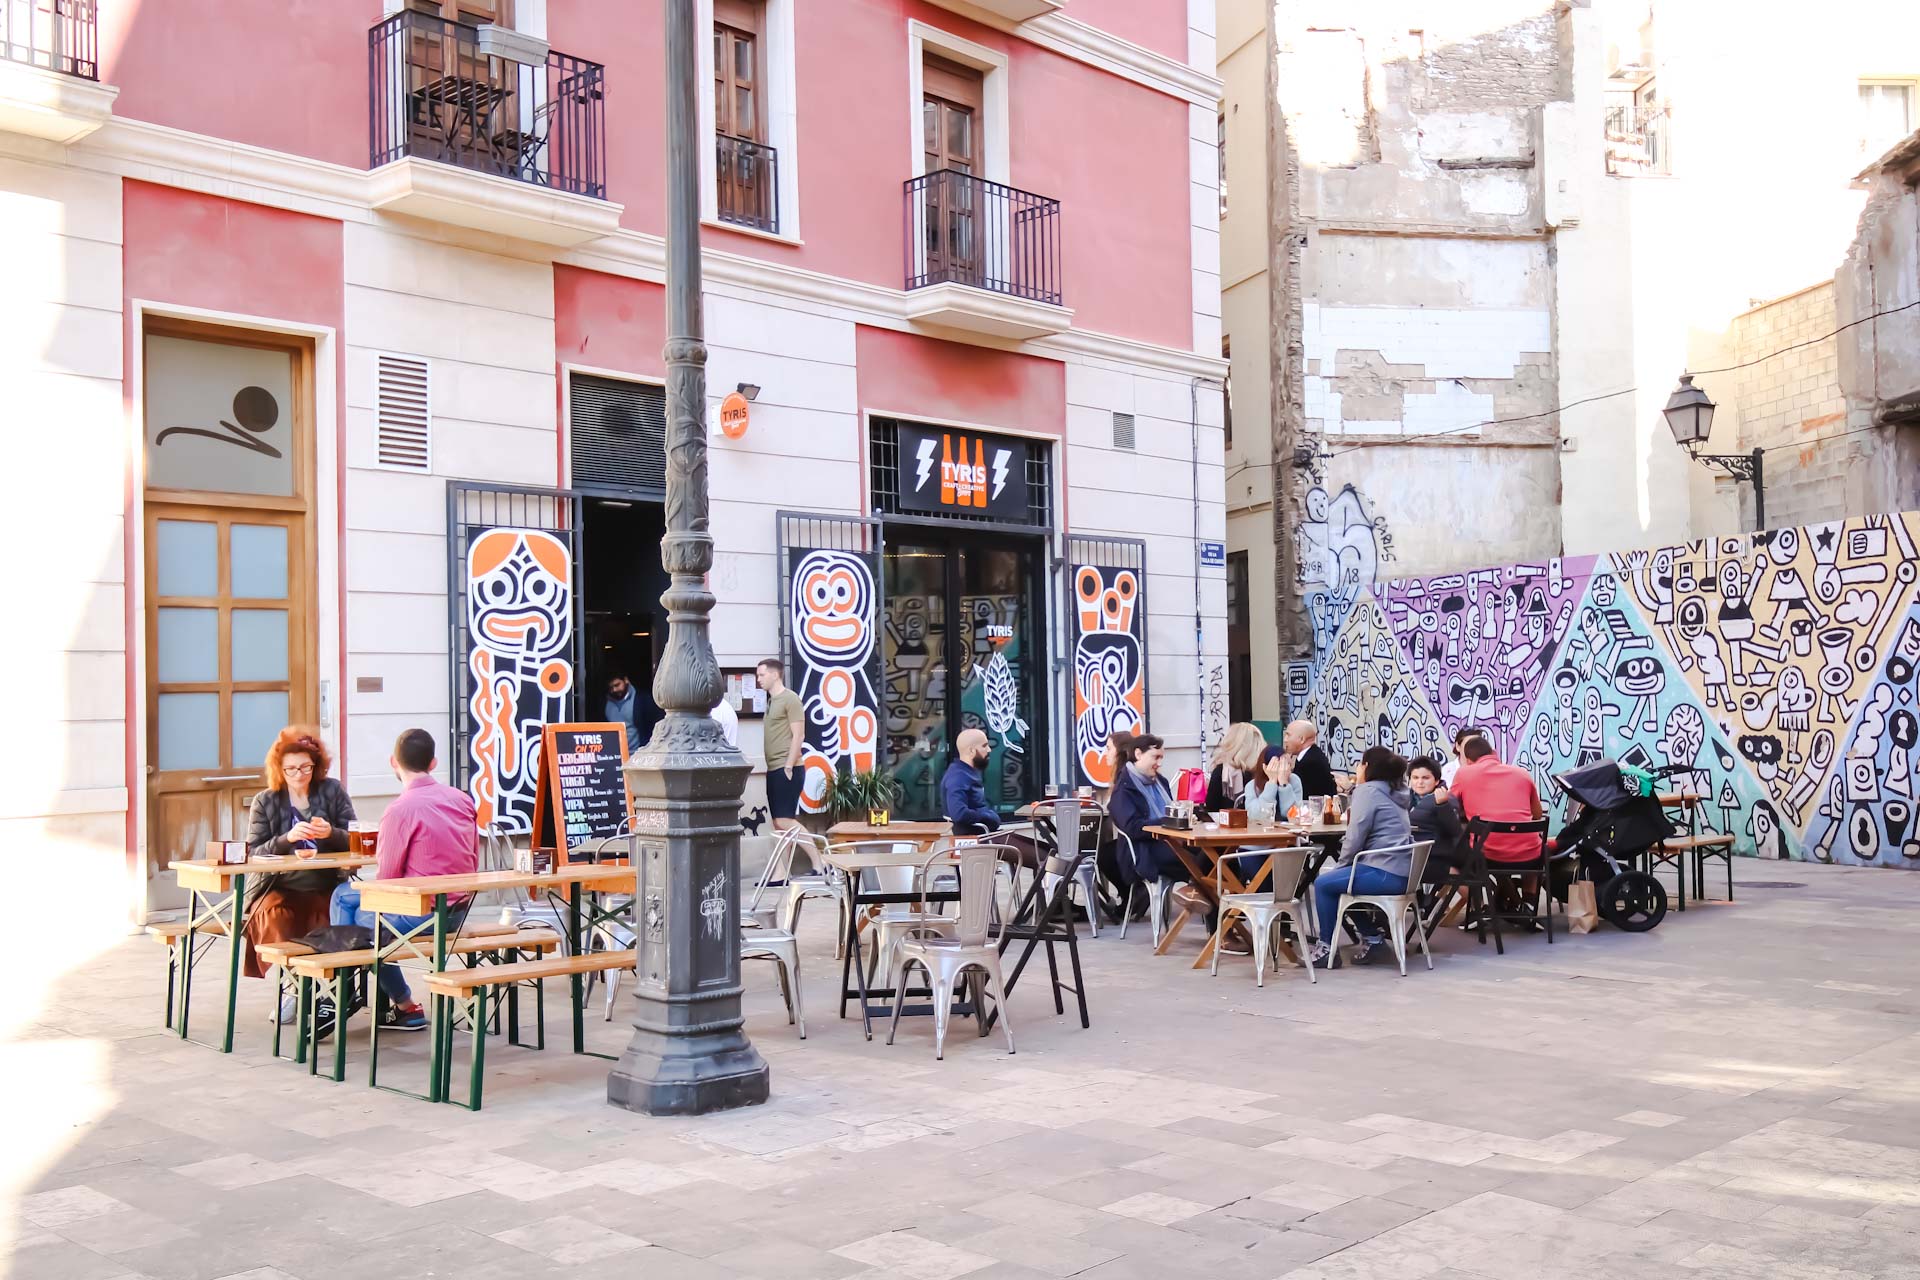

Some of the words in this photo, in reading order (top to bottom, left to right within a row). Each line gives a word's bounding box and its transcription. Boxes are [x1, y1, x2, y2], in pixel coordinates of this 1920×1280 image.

[723, 408, 747, 421] TYRIS
[941, 461, 986, 484] TYRIS
[986, 625, 1013, 637] TYRIS
[574, 735, 603, 744] TYRIS
[589, 745, 603, 753] TAP
[558, 753, 597, 764] ORIGINAL
[560, 776, 586, 788] TRIGO
[564, 799, 585, 810] VIPA
